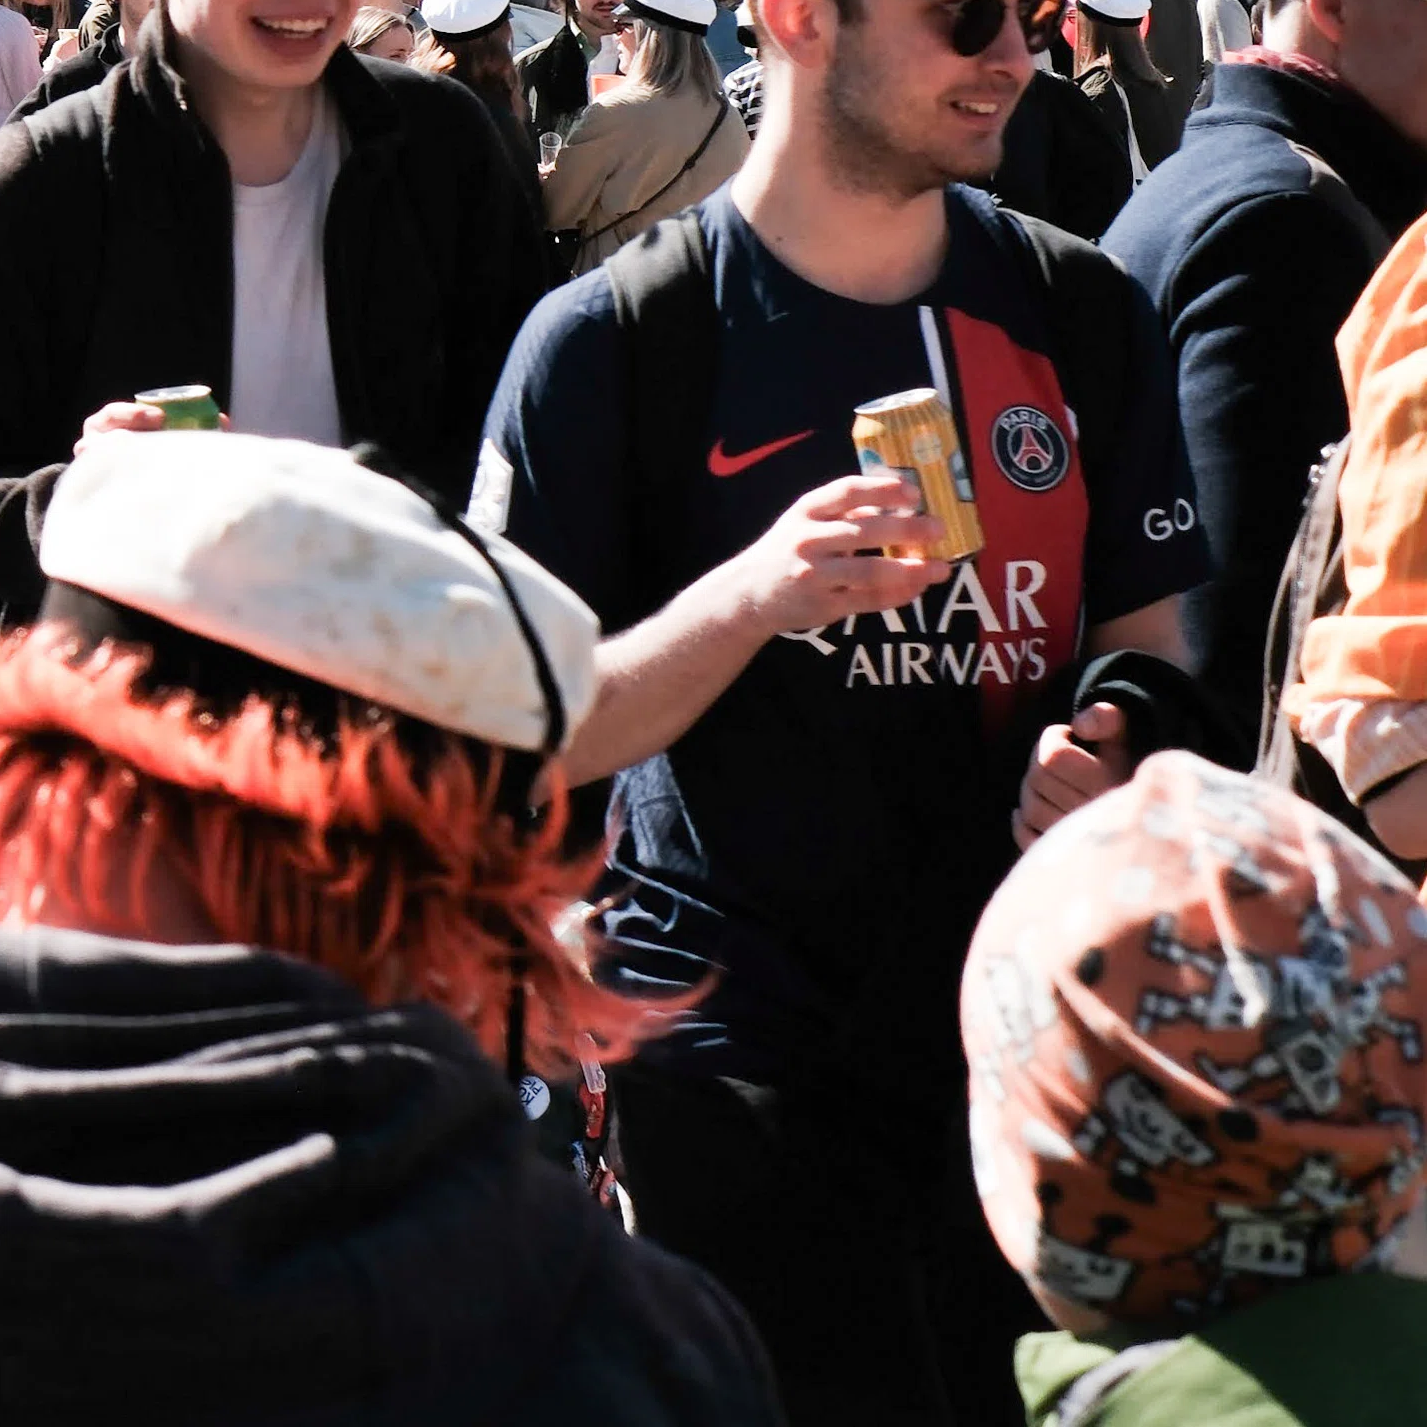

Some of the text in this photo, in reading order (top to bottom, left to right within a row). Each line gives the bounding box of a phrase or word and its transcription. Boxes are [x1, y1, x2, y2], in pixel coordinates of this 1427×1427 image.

[999, 410, 1047, 431] PARIS
[1143, 497, 1196, 542] GO
[847, 636, 1047, 689] AIRWAYS
